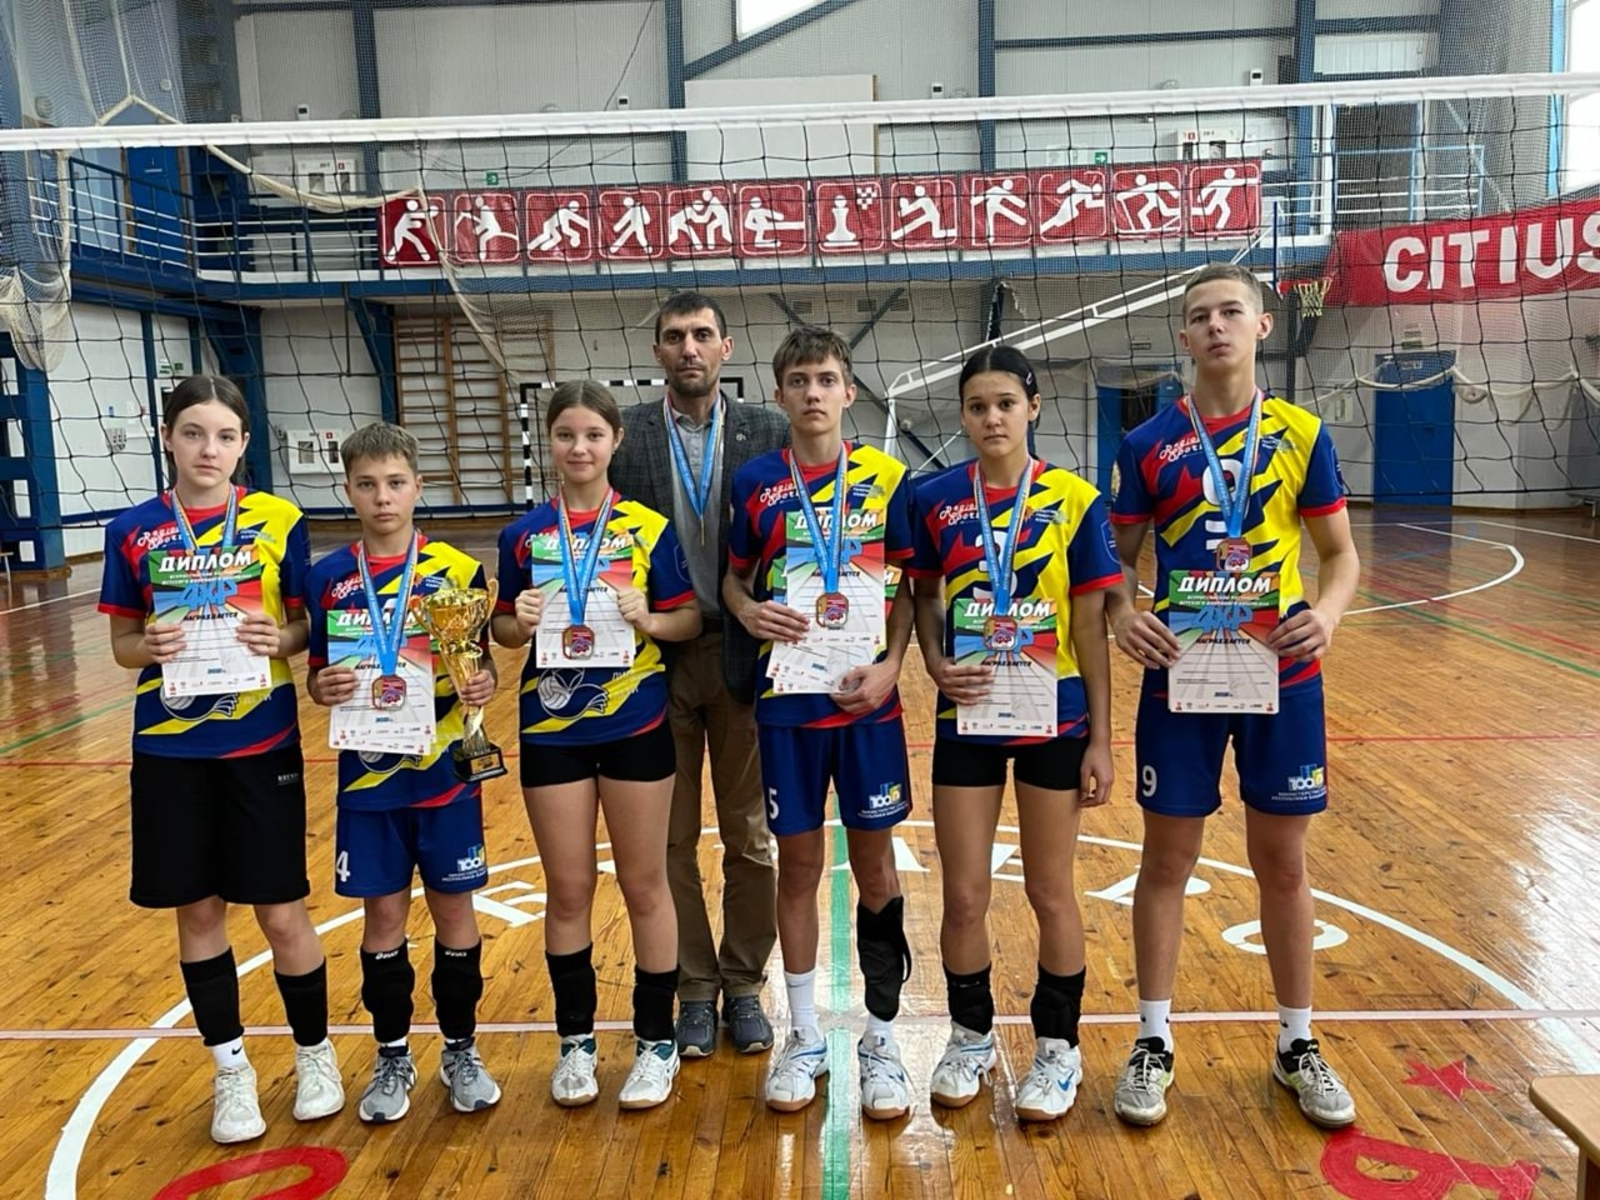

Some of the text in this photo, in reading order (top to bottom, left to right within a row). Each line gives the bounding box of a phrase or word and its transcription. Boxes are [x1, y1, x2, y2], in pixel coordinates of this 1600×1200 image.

[1384, 211, 1600, 293] CITIUS
[794, 513, 877, 529] ДПОМ
[543, 536, 626, 550] ДПОМ
[158, 550, 251, 572] ДИПЛОМ
[1177, 577, 1271, 592] ДИПЛОМ
[964, 602, 1051, 617] ДИЛОМ
[1142, 765, 1157, 797] 9
[768, 787, 780, 820] 5
[336, 850, 351, 882] 4
